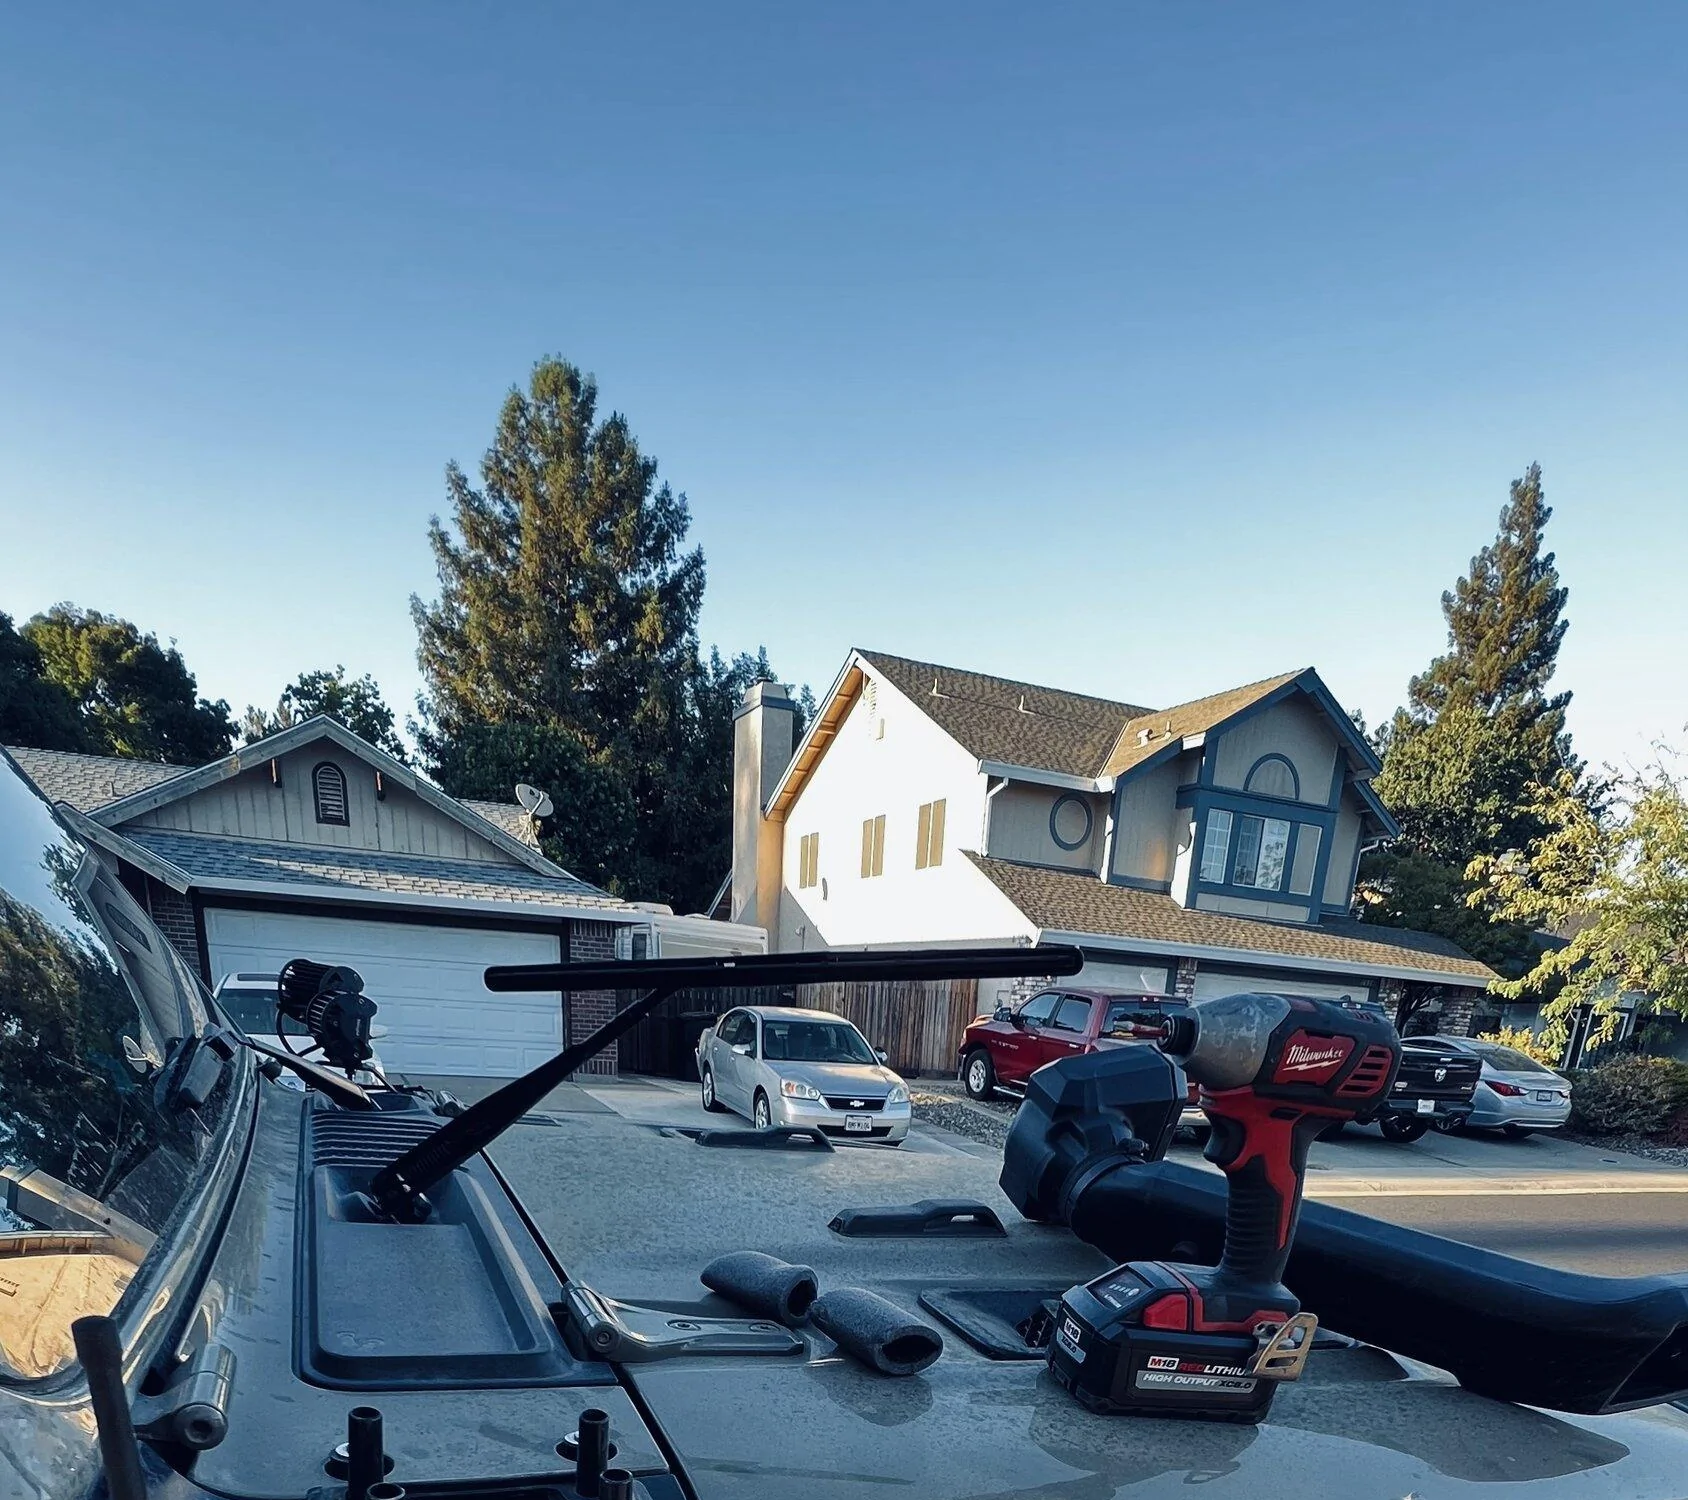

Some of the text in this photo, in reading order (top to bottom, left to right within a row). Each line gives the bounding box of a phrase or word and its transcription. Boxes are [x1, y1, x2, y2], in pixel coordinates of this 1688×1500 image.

[1286, 1044, 1343, 1065] Milwaukee
[1150, 1357, 1177, 1369] M18
[1143, 1374, 1172, 1384] HIGH
[1174, 1376, 1218, 1386] OUTPUT
